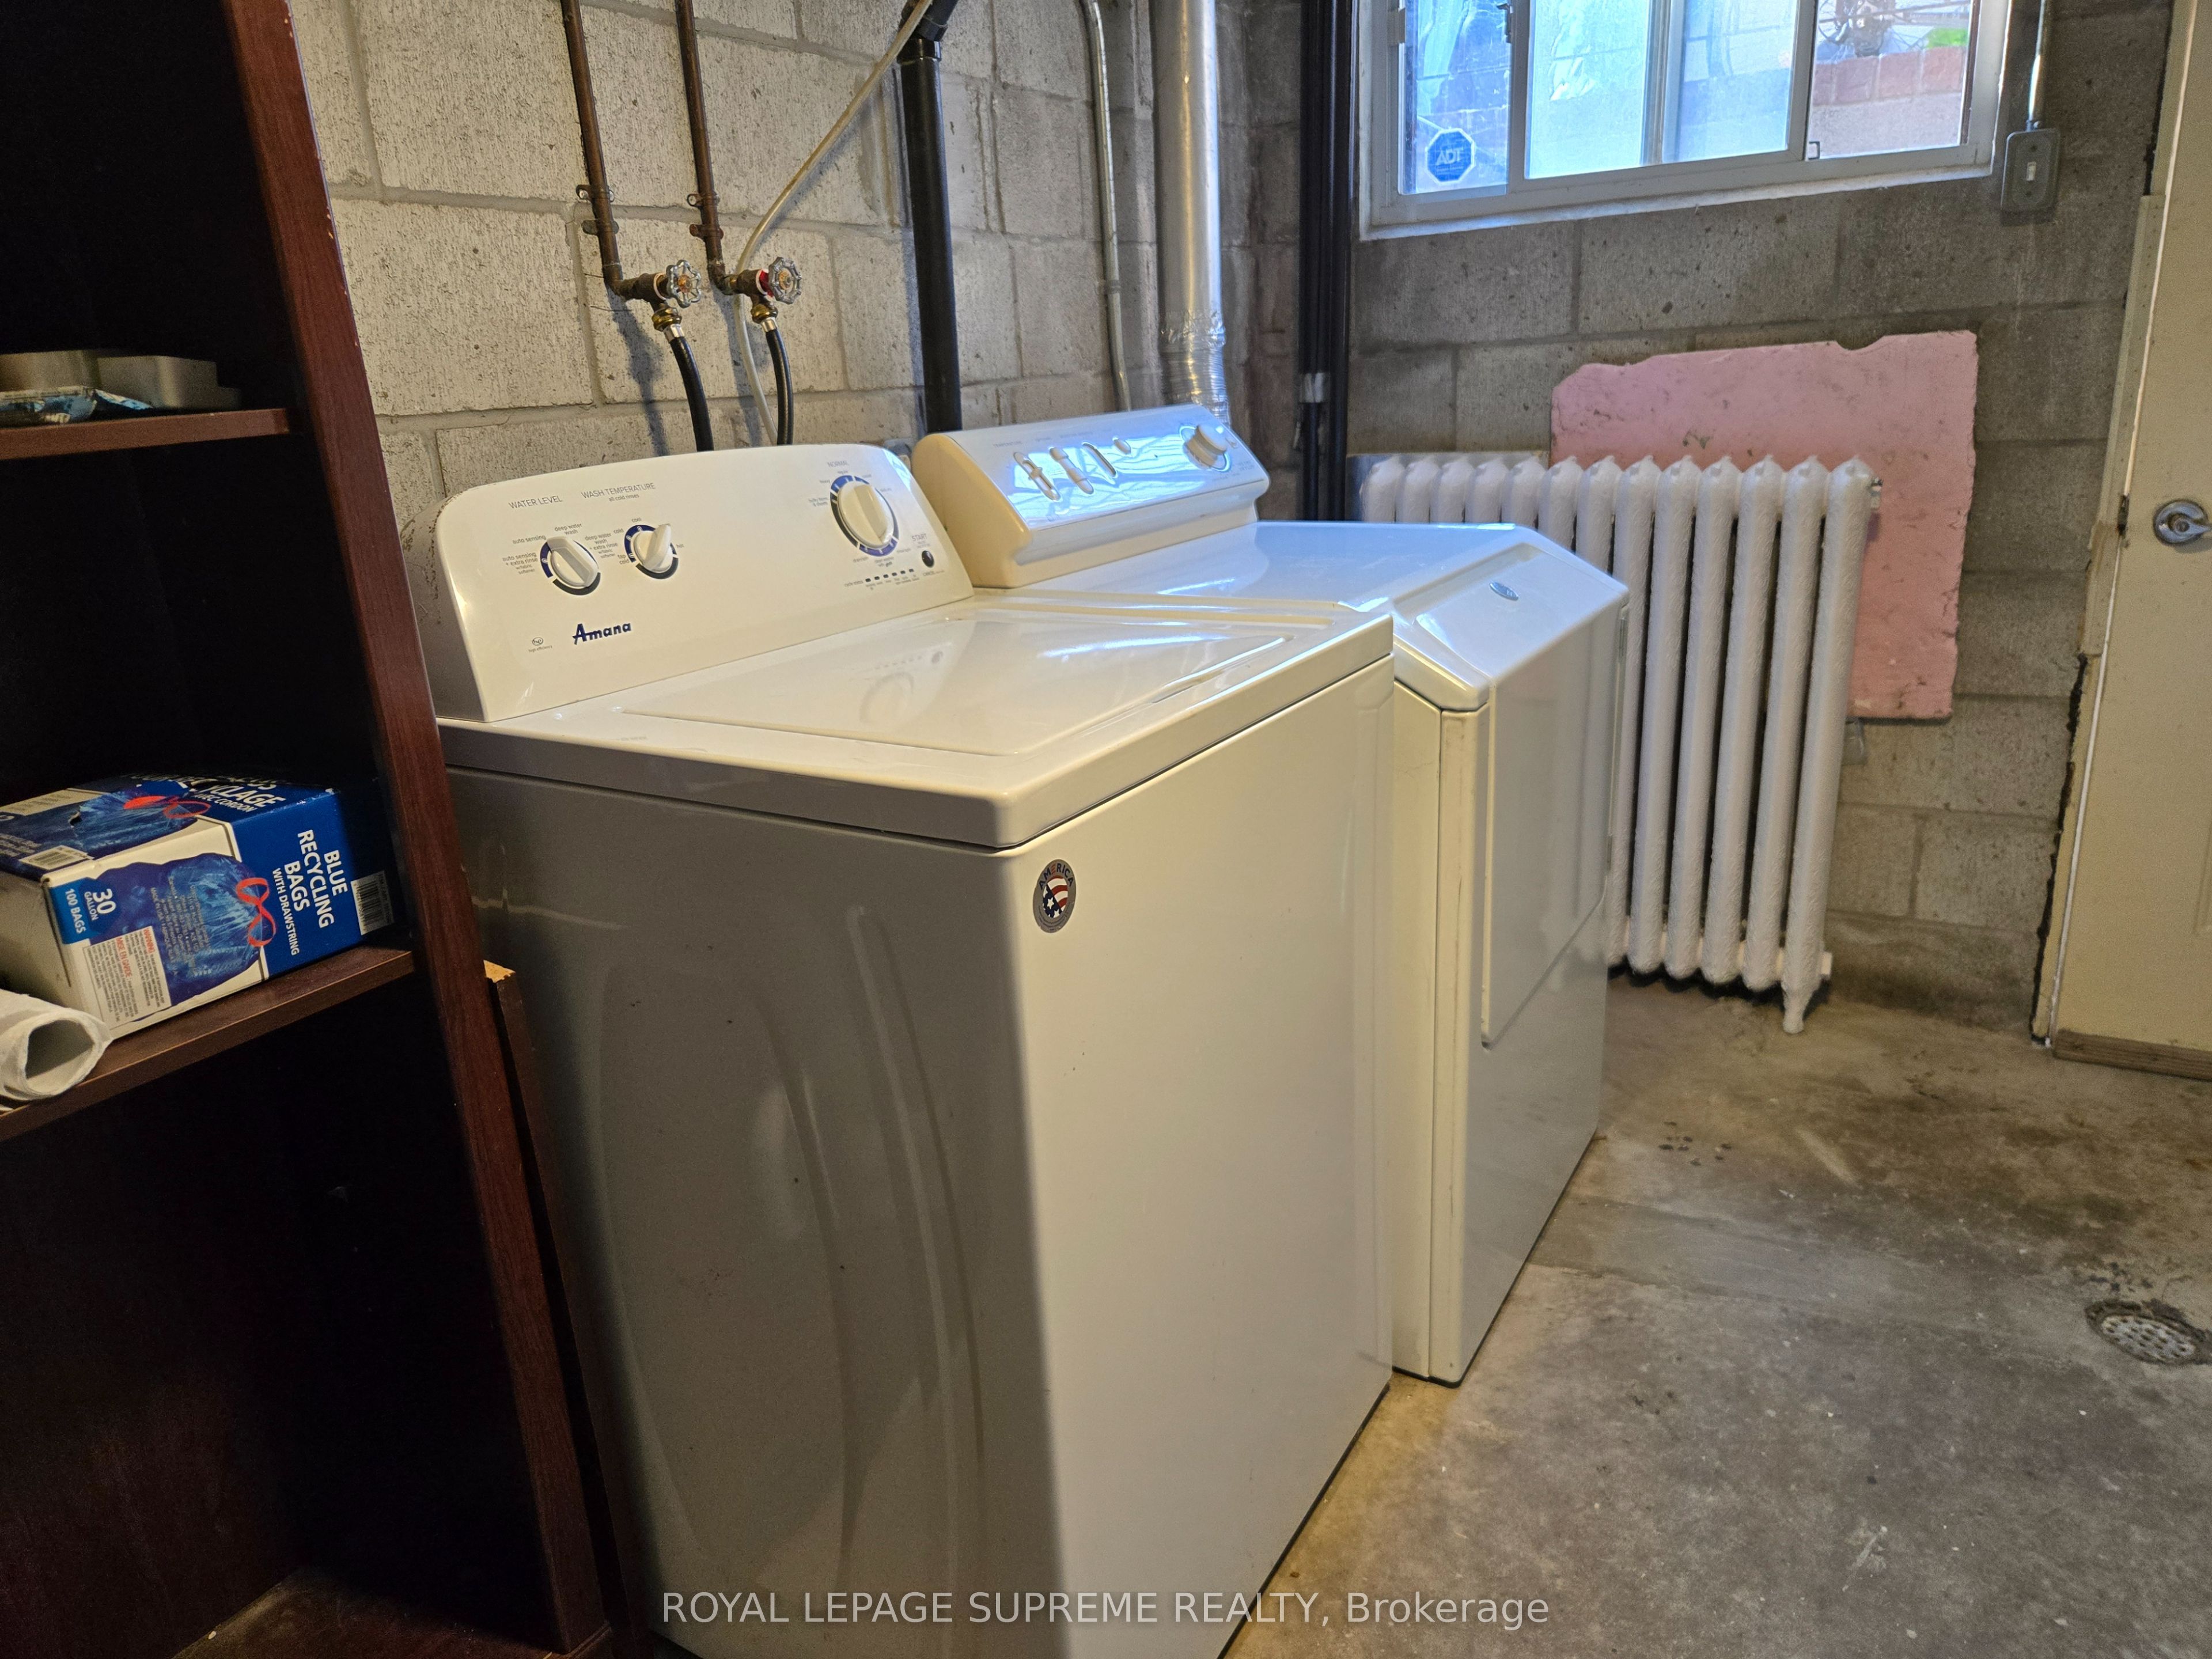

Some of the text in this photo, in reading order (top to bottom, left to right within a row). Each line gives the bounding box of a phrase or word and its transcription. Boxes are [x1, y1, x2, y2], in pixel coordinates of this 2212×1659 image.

[1435, 147, 1464, 166] ADT
[508, 495, 563, 509] WATER LEVEL
[581, 482, 656, 499] WASH TEMPERATURE
[525, 535, 547, 543] sensing
[911, 533, 928, 541] START
[572, 623, 632, 646] Amana
[214, 797, 259, 813] CORDON
[297, 829, 335, 929] RECYCLING
[323, 849, 349, 896] BLUE
[283, 860, 310, 912] BAGS
[65, 888, 86, 934] 100 BAGS
[84, 891, 99, 921] GALLON
[92, 888, 116, 914] 30
[272, 867, 300, 956] WITH DRAWSTRING
[143, 927, 156, 954] WARNING
[115, 937, 132, 978] MISE EN GARDE
